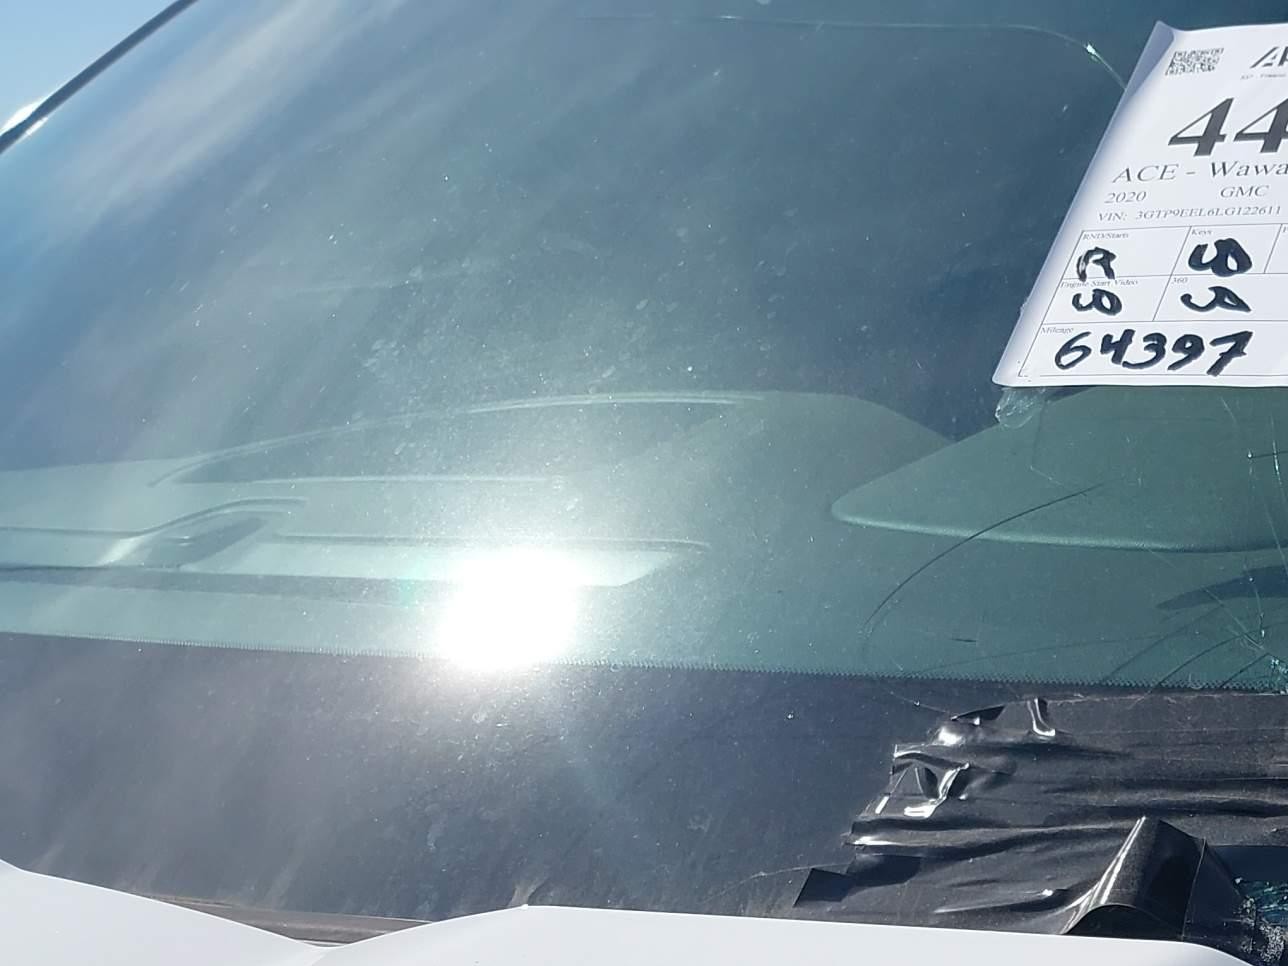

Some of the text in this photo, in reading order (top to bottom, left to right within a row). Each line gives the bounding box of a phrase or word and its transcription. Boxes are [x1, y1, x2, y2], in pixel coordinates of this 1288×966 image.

[1112, 163, 1180, 184] ACE
[1104, 190, 1147, 204] 2020
[1219, 184, 1270, 198] GMC
[1098, 211, 1128, 222] VIN:
[1191, 228, 1213, 237] Keys
[1054, 328, 1254, 377] 64397
